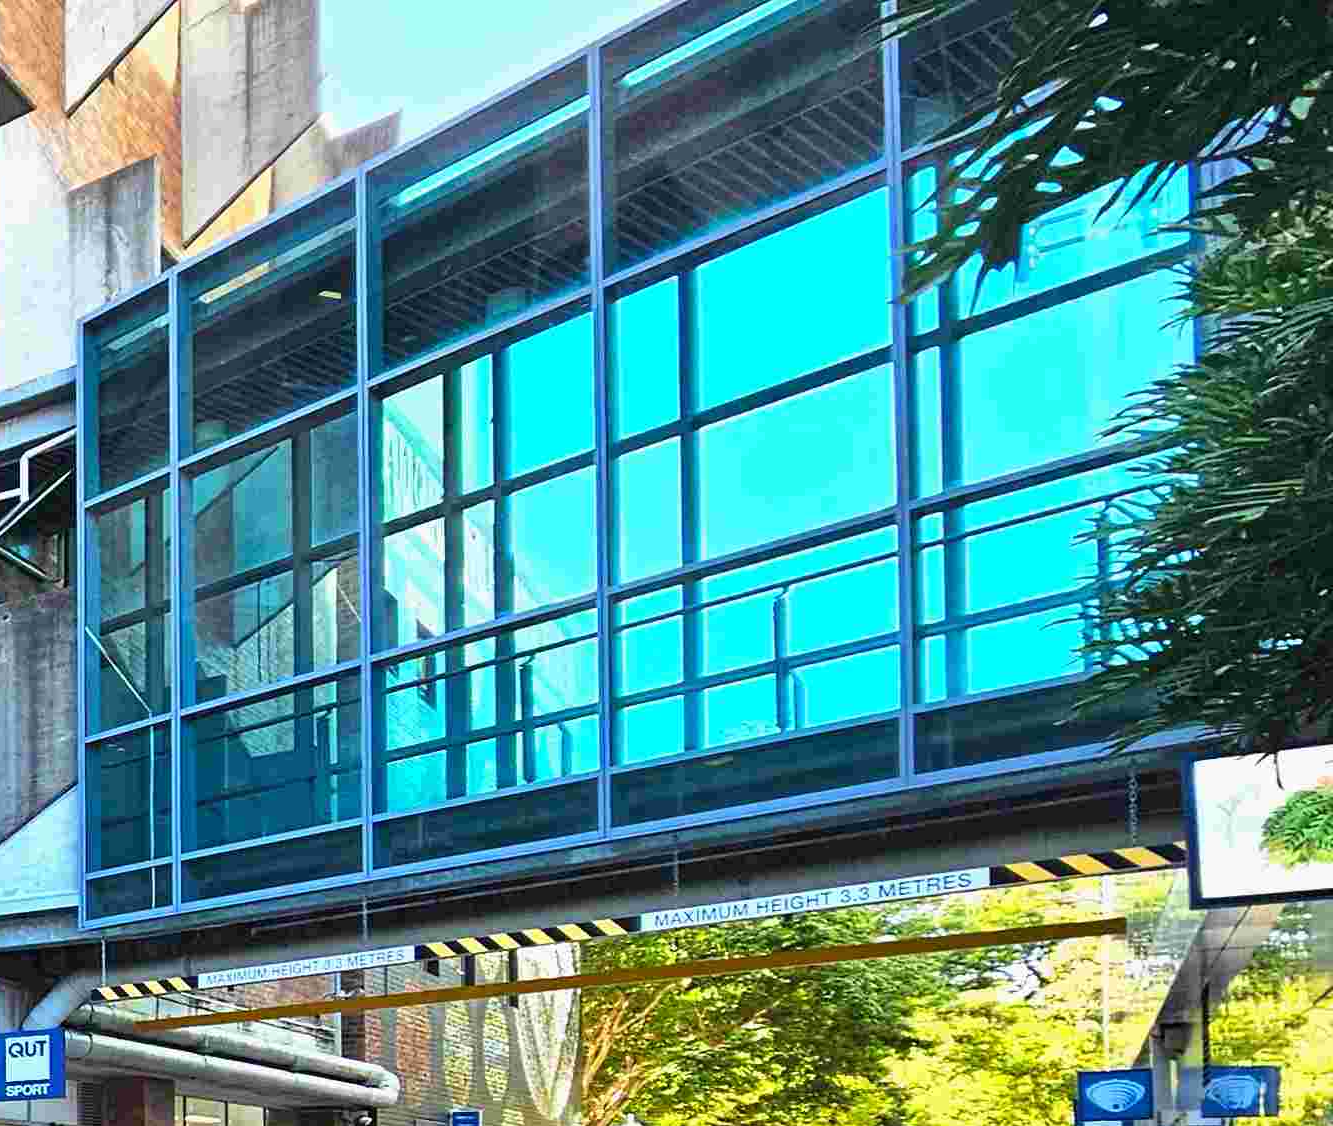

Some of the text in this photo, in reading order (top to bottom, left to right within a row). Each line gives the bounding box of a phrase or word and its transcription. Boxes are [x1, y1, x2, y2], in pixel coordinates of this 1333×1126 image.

[654, 873, 972, 927] MAXIMUM HEIGHT 3.3 METRES
[205, 966, 266, 985] MAXIMUM
[268, 960, 318, 978] HEIGHT
[347, 950, 405, 969] METRES
[8, 1040, 47, 1058] QUT
[5, 1083, 50, 1097] SPORT
